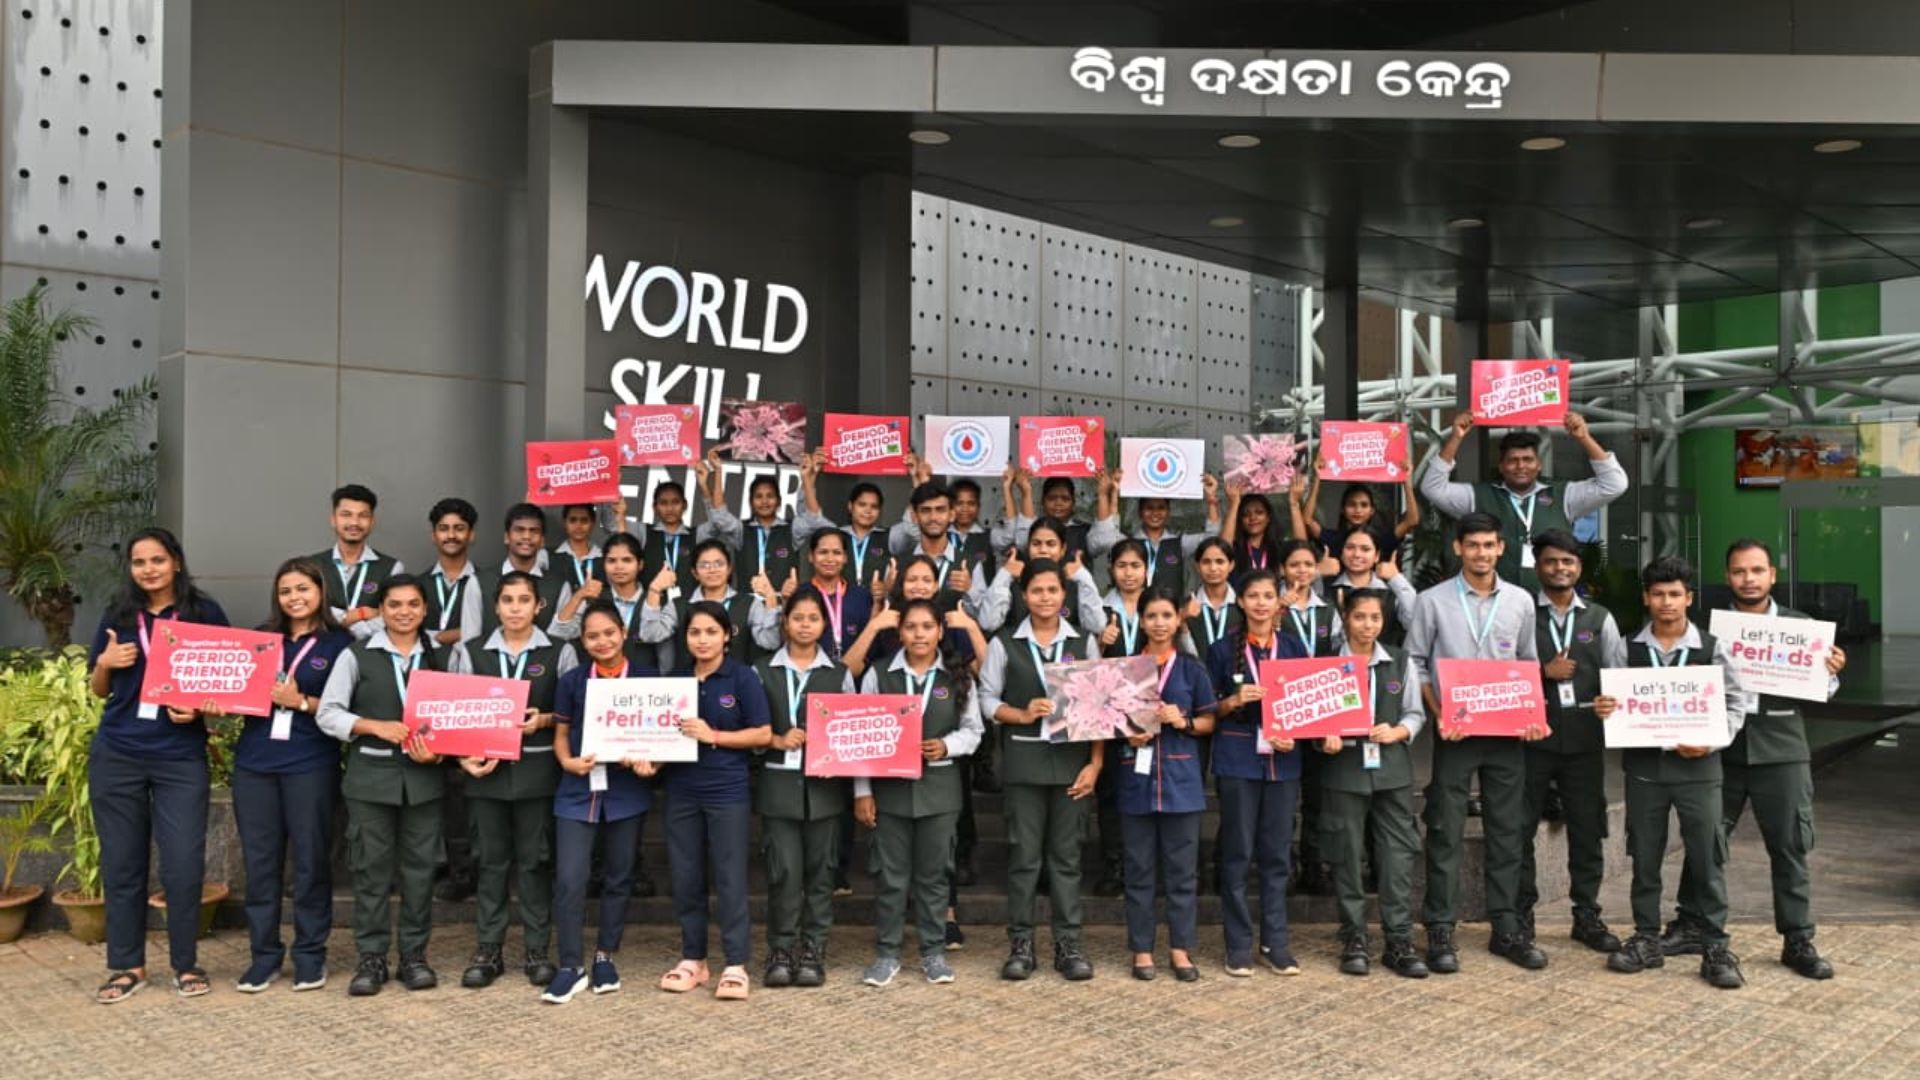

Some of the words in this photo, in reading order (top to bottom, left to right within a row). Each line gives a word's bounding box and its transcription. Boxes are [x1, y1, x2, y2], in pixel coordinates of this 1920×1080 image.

[1190, 59, 1351, 95] ଦକ୍ଷତା
[1376, 61, 1510, 109] କେନ୍ଦ୍ର
[585, 253, 808, 354] WORLD
[1490, 402, 1516, 417] FOR
[1519, 396, 1542, 409] ALL
[637, 416, 675, 426] PERIOD
[843, 426, 887, 443] PERIOD
[1043, 427, 1080, 437] PERIOD
[638, 443, 659, 453] FOR
[661, 440, 678, 450] ALL
[834, 434, 899, 456] EDUCATION
[1039, 436, 1083, 446] FRIENDLY
[840, 453, 862, 465] FOR
[865, 447, 884, 459] ALL
[1044, 454, 1065, 464] FOR
[1066, 452, 1082, 462] ALL
[1367, 456, 1383, 465] ALL
[539, 466, 563, 477] END
[565, 458, 608, 473] PERIOD
[552, 472, 597, 485] STIGMA
[1741, 628, 1774, 642] Let's
[1780, 632, 1808, 646] Talk
[173, 652, 248, 664] #PERIOD
[174, 666, 252, 677] FRIENDLY
[181, 679, 243, 691] WORLD
[1287, 671, 1338, 696] PERIOD
[1633, 682, 1666, 695] Let's
[1671, 682, 1699, 694] Talk
[1275, 680, 1356, 715] EDUCATION
[1454, 688, 1480, 699] END
[1484, 683, 1531, 696] PERIOD
[419, 703, 450, 714] END
[455, 701, 511, 713] PERIOD
[613, 694, 643, 707] Let's
[648, 694, 674, 706] Talk
[1469, 697, 1521, 710] STIGMA
[1284, 709, 1315, 725] FOR
[1318, 700, 1342, 716] ALL
[434, 715, 494, 728] STIGMA
[829, 717, 894, 732] #PERIOD
[832, 730, 899, 745] FRIENDLY
[840, 744, 893, 759] WORLD
